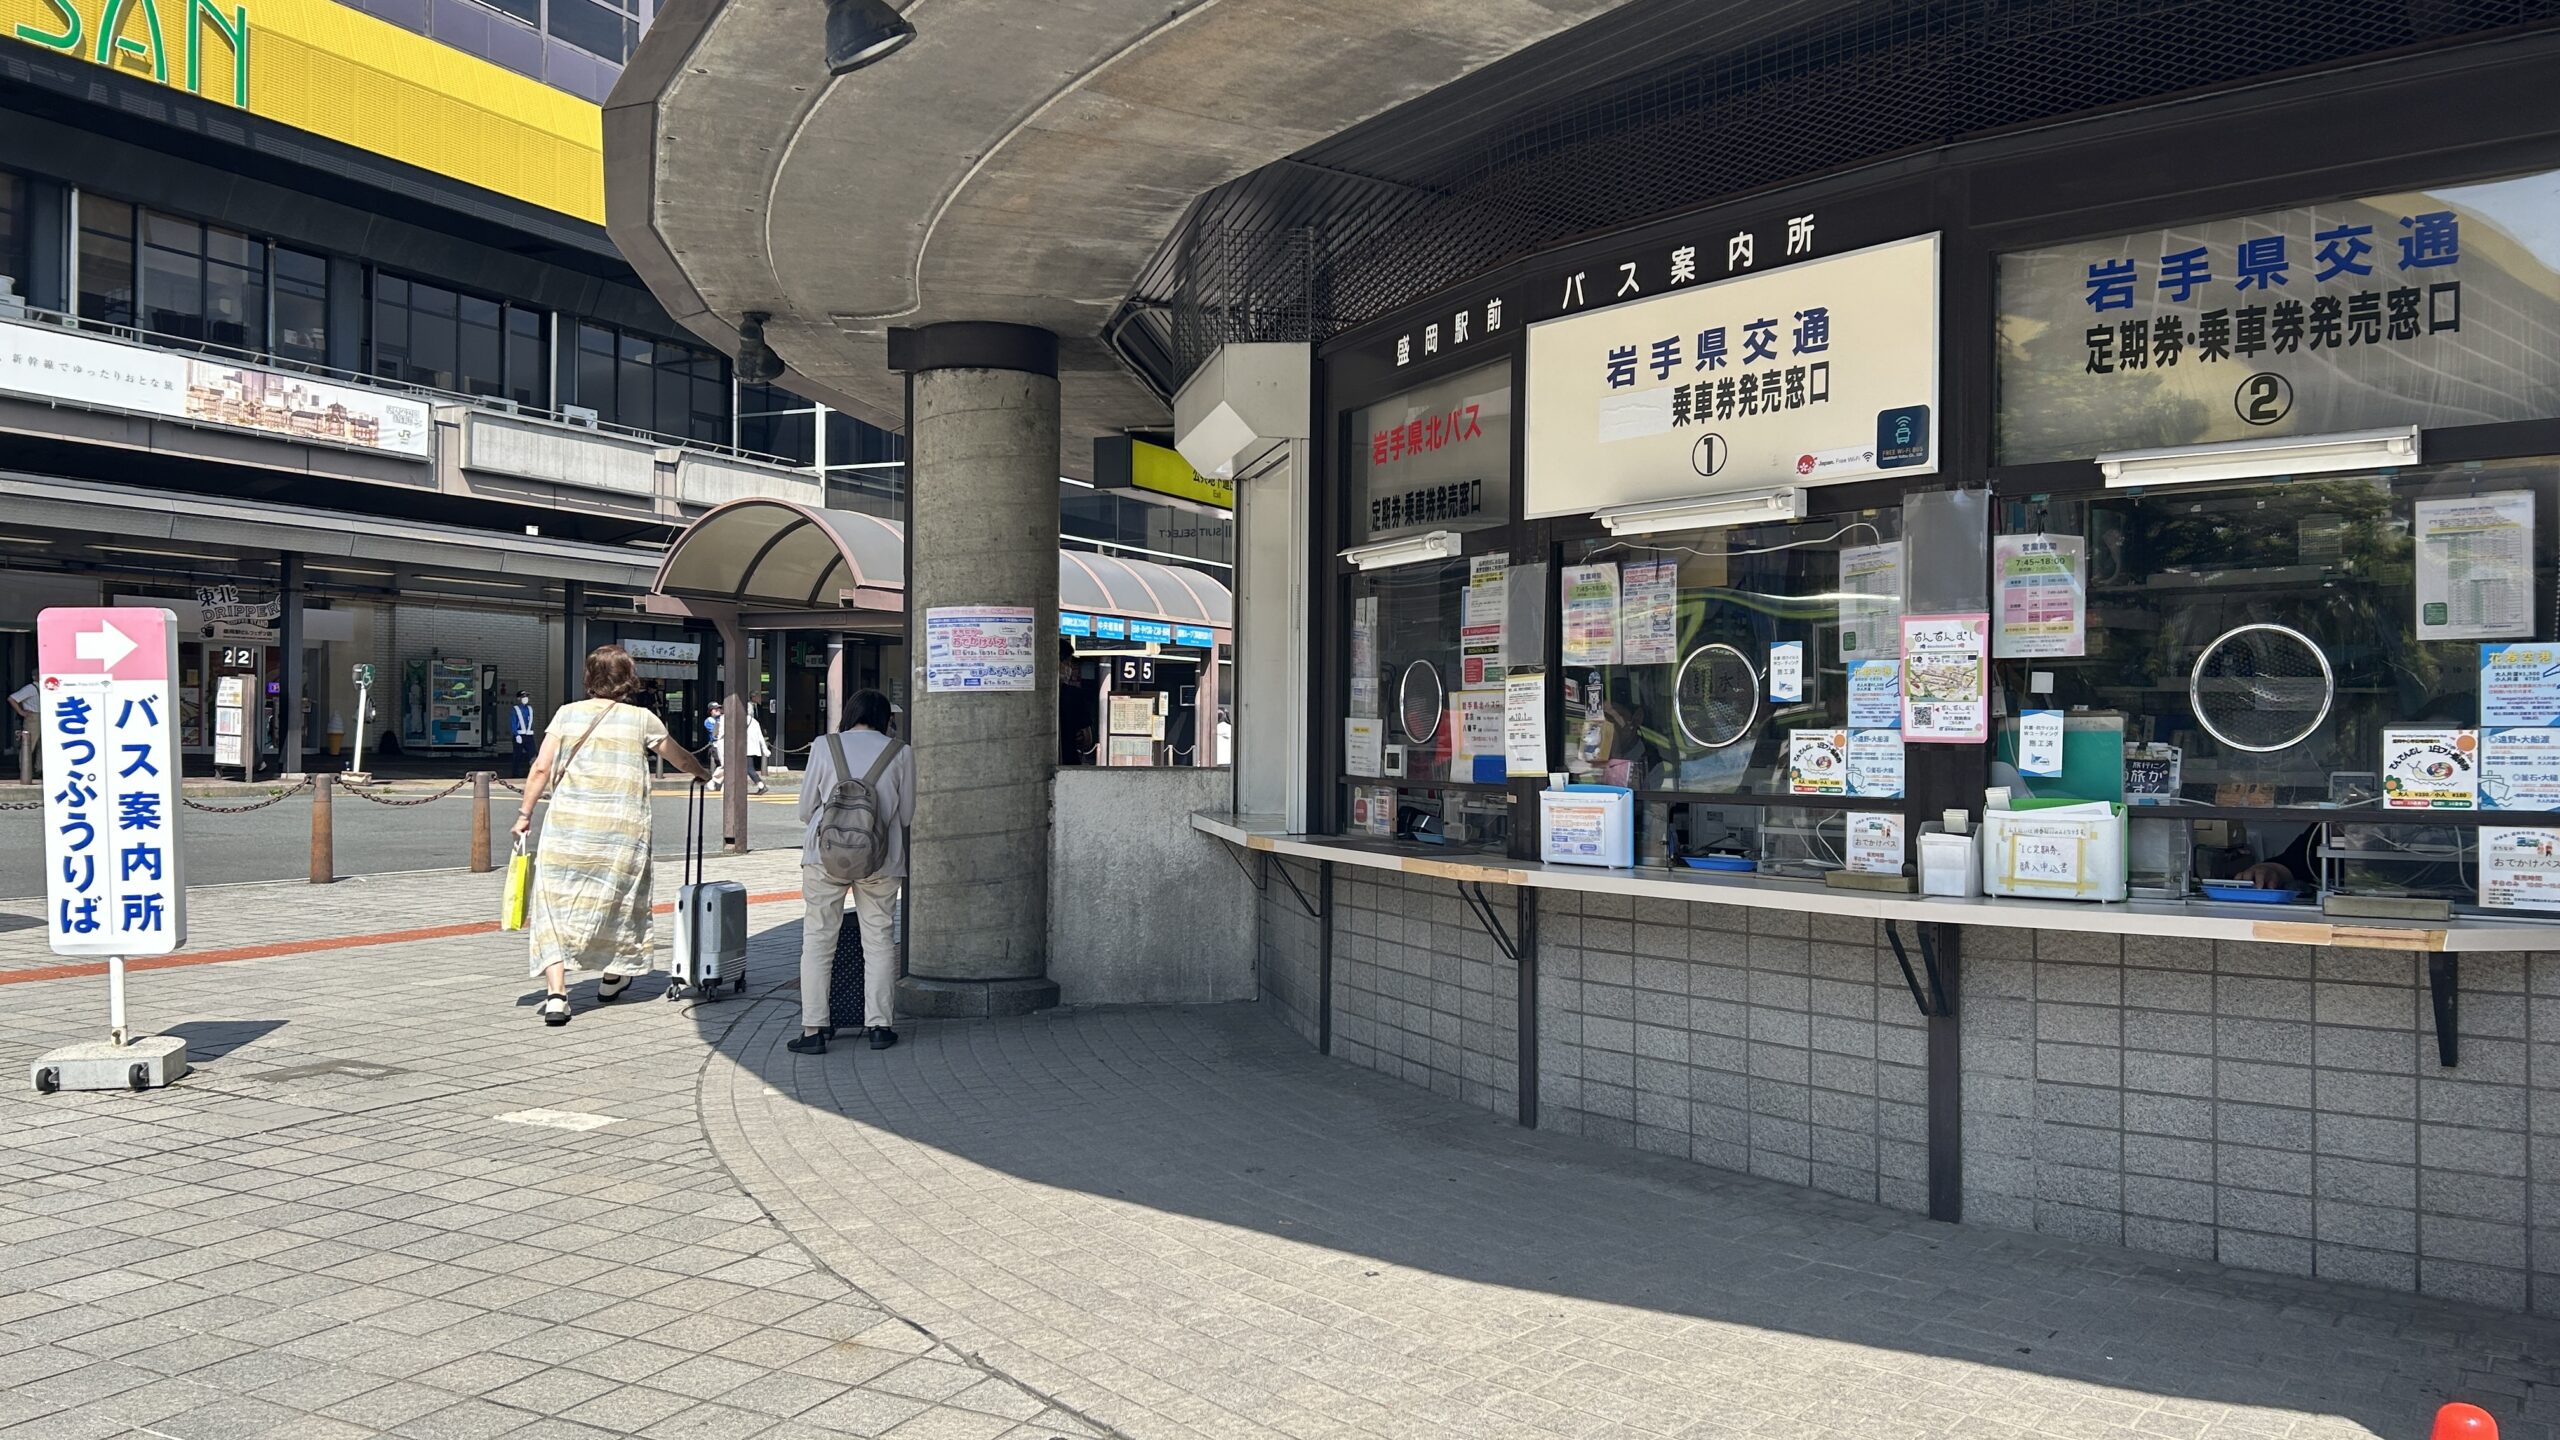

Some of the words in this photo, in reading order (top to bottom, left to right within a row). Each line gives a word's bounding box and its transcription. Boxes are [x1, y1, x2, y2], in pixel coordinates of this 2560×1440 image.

[1562, 213, 1815, 310] バス案内所
[2086, 209, 2461, 313] 岩手県交通
[1397, 297, 1502, 367] 盛岡駅前
[1607, 306, 1830, 390] 岩手県交通
[2085, 280, 2462, 375] 定期券・乗車券発売窓口
[1672, 360, 1830, 429] 乗車券発売窓口
[1373, 404, 1482, 466] 岩手県北バス
[1370, 478, 1482, 532] 定期券・乗車券発売窓口
[2022, 543, 2057, 552] 営業時間
[199, 585, 239, 607] 東北
[224, 650, 233, 663] 2
[238, 651, 250, 664] 2
[1123, 662, 1136, 679] 5
[1143, 663, 1152, 679] 5
[54, 696, 103, 934] きっぷうりば
[115, 694, 164, 932] バス案内所
